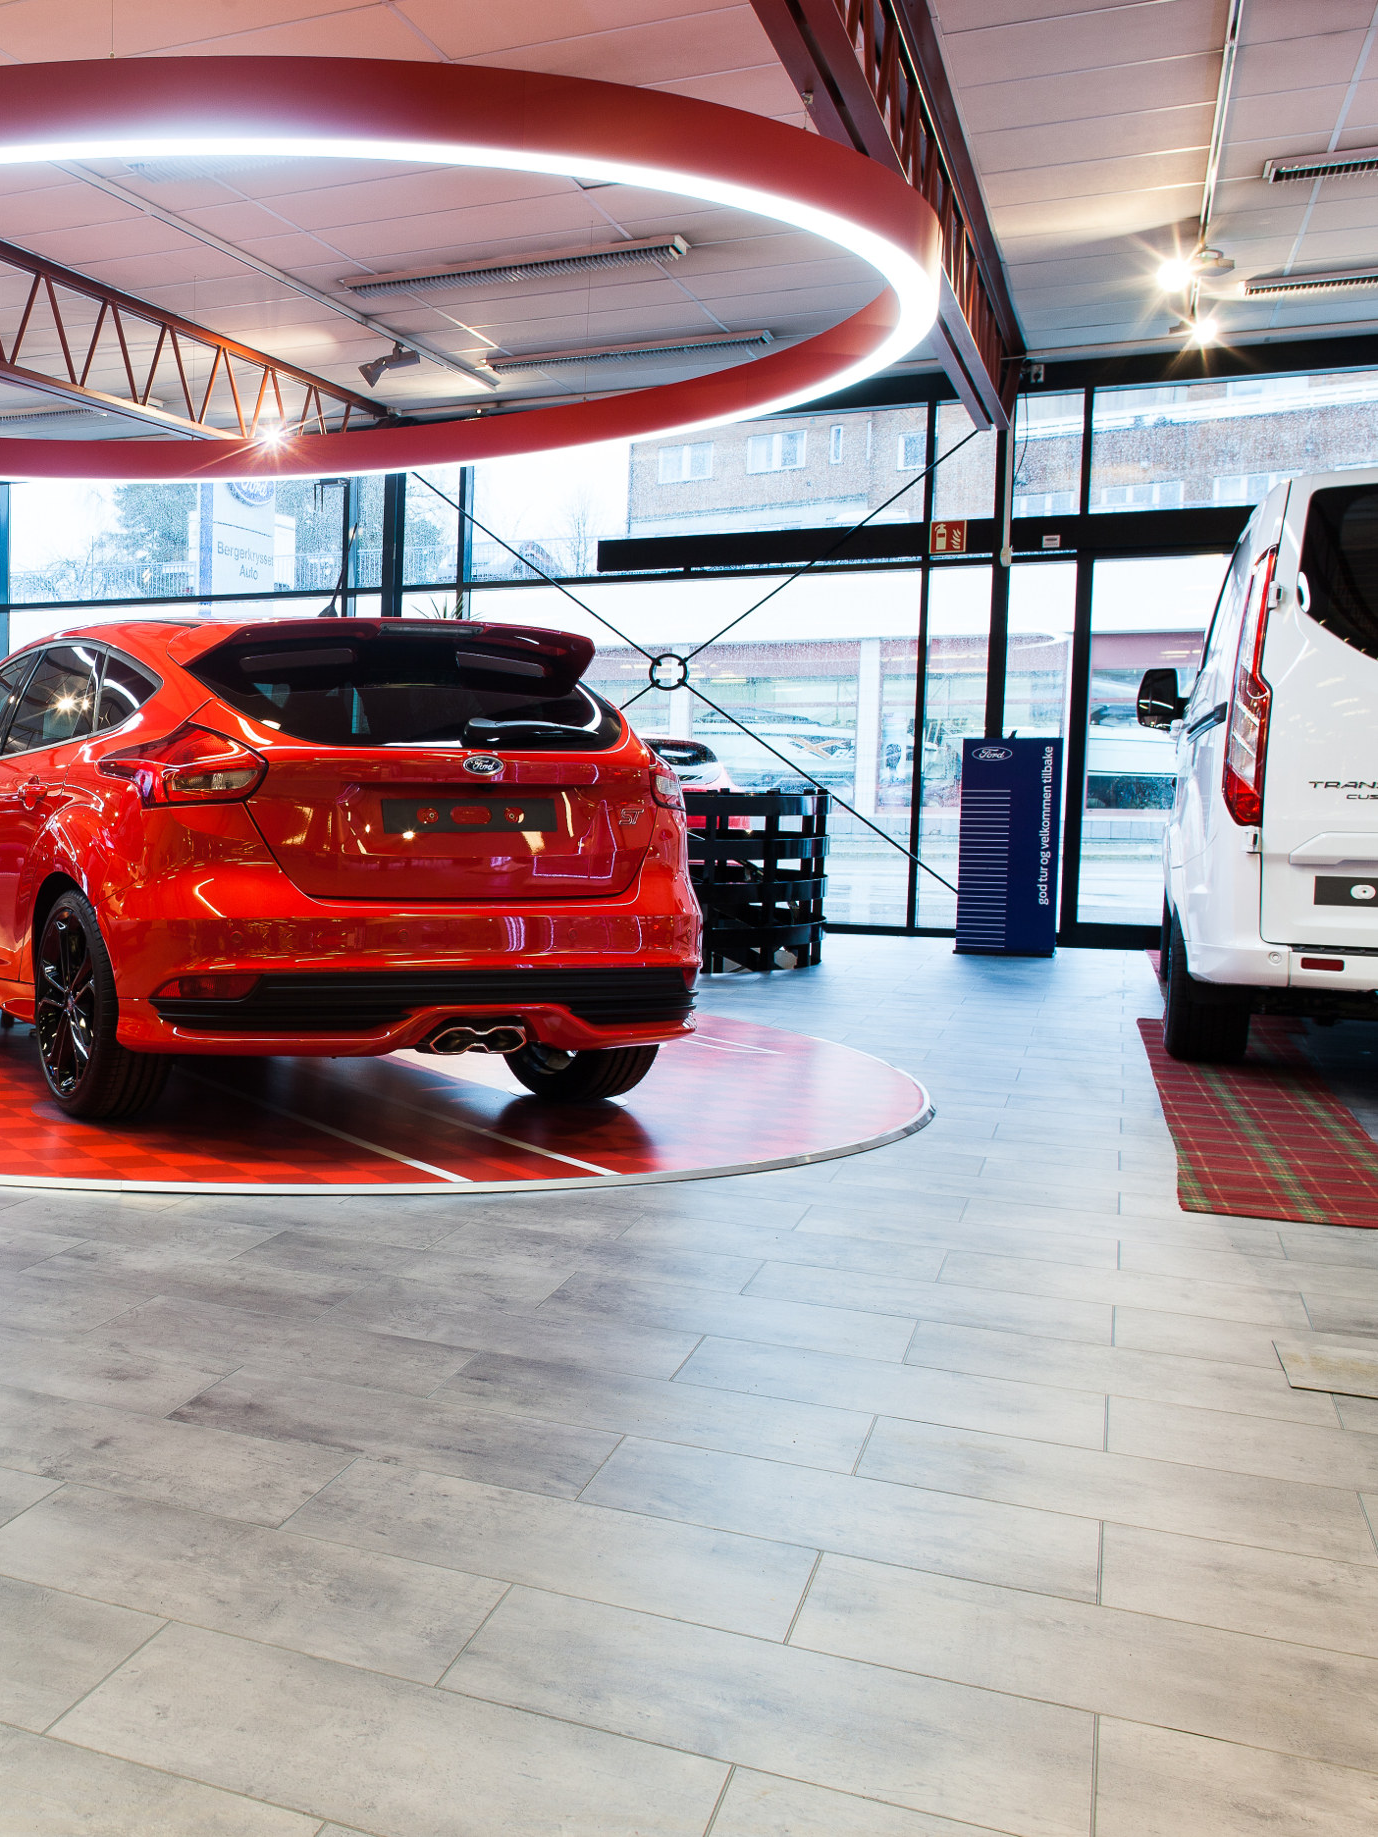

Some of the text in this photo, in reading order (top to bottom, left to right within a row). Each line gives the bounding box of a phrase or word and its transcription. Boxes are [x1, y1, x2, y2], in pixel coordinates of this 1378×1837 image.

[239, 564, 259, 580] Auto
[1308, 780, 1378, 789] TRAN
[618, 808, 645, 825] ST
[1036, 746, 1054, 906] god tur og velkommen tilbake
